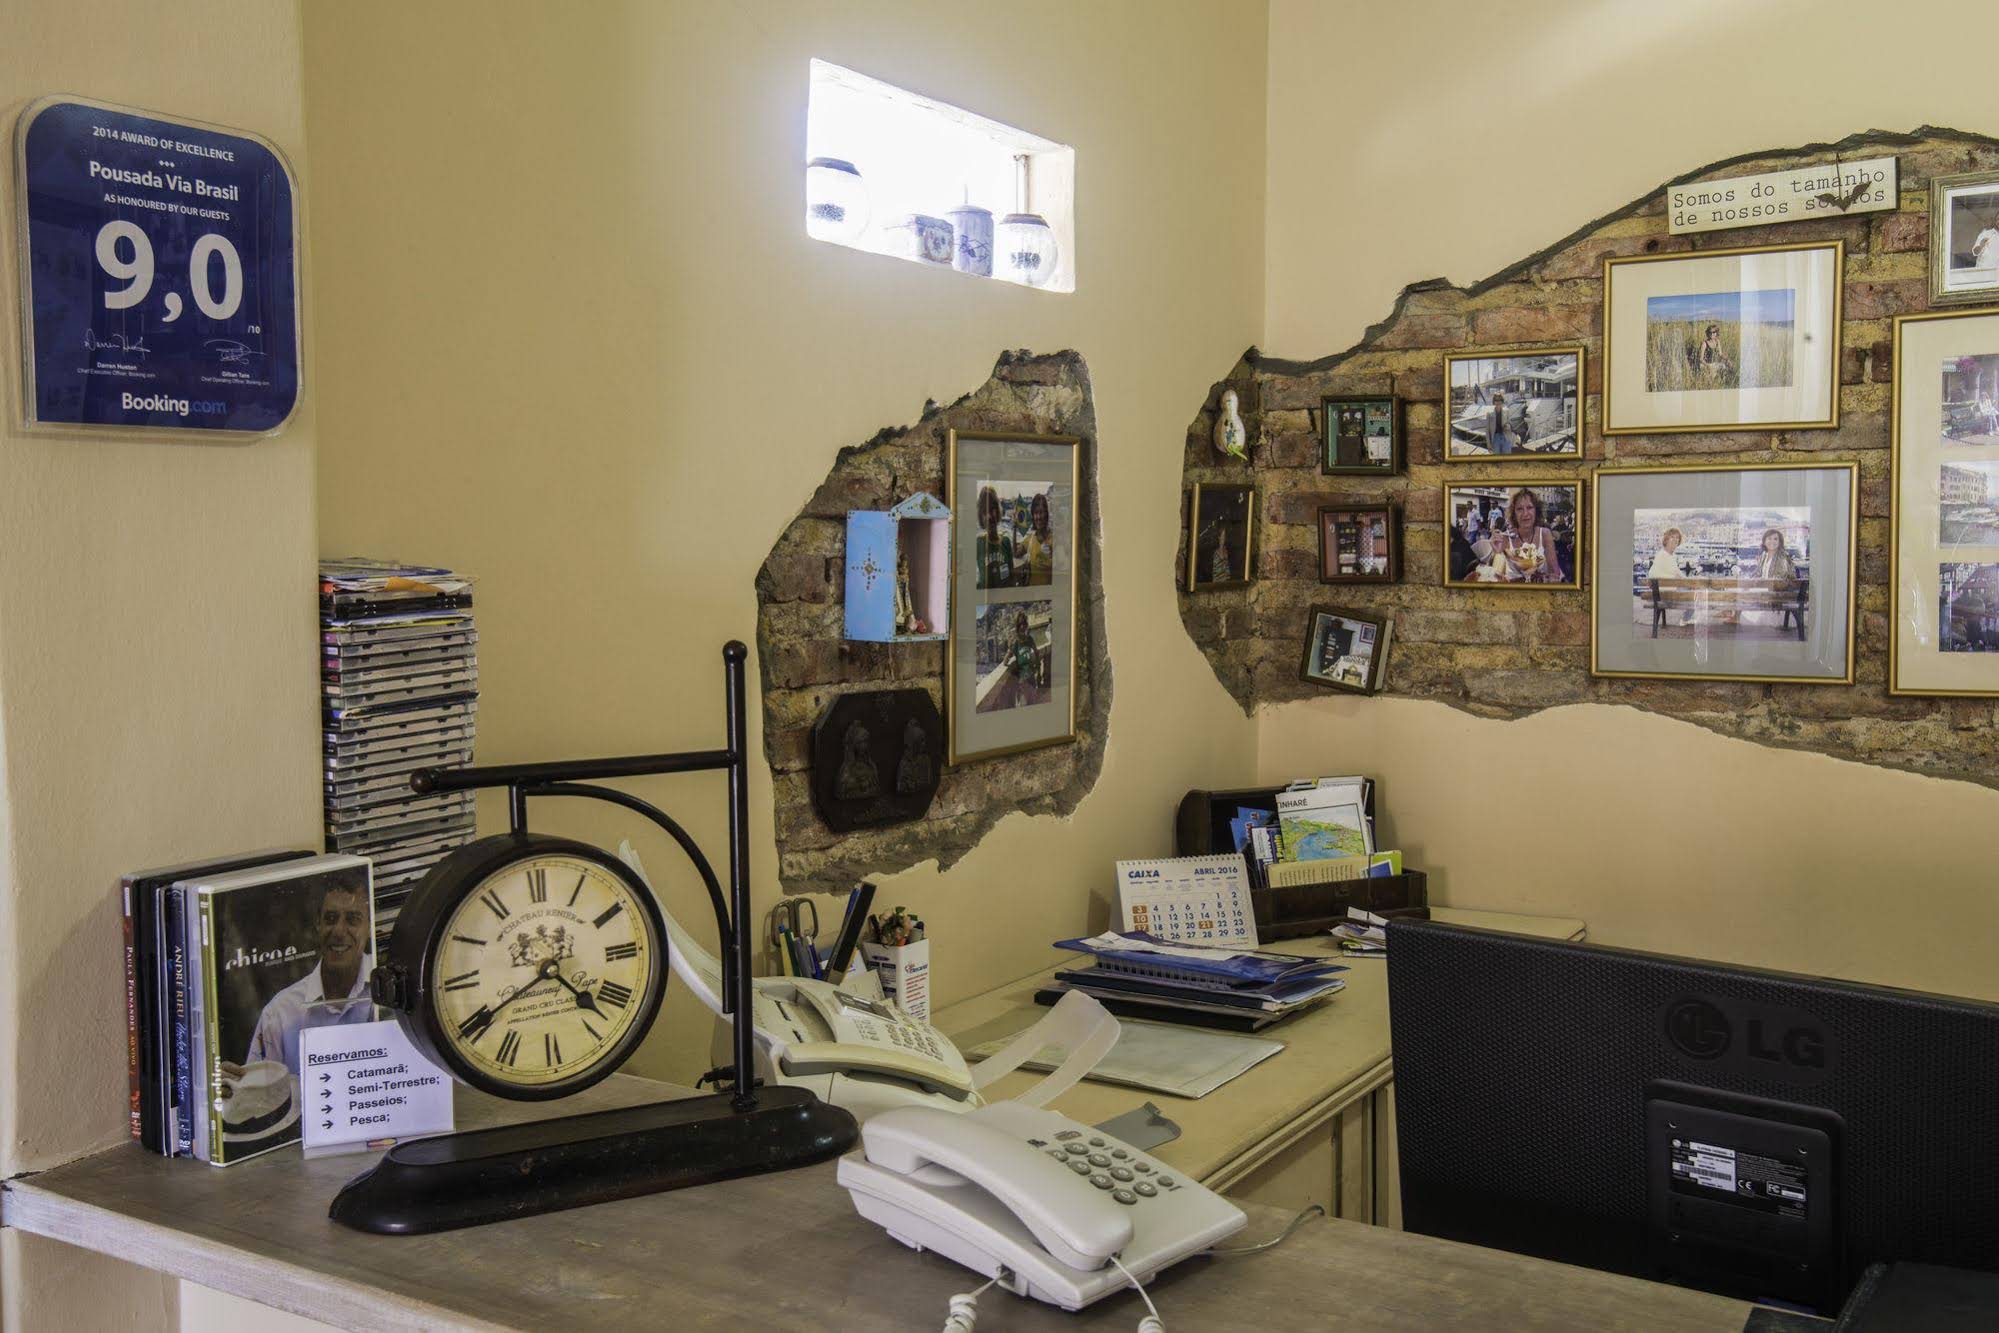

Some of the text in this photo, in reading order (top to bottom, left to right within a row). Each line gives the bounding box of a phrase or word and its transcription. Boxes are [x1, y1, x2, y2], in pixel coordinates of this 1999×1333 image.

[93, 126, 235, 162] 2014 AWARD OF EXCELLENCE
[89, 160, 239, 201] Pousada Via Brasil
[1674, 168, 1885, 209] Somos do tamanho
[104, 193, 230, 221] AS HONOURED BY OUR GUESTS
[1674, 211, 1698, 227] de
[1711, 201, 1789, 222] nossos
[95, 219, 243, 323] 9,0
[122, 392, 226, 416] Booking.com
[1128, 870, 1160, 879] CAIXA
[1235, 928, 1245, 936] 30
[513, 1003, 538, 1015] GRAND
[308, 1047, 388, 1065] Reservamos:
[347, 1064, 409, 1080] Catamarã;
[348, 1075, 440, 1095] Semi-Terrestre;
[349, 1095, 407, 1111] Passeios;
[350, 1113, 391, 1126] Pesca;
